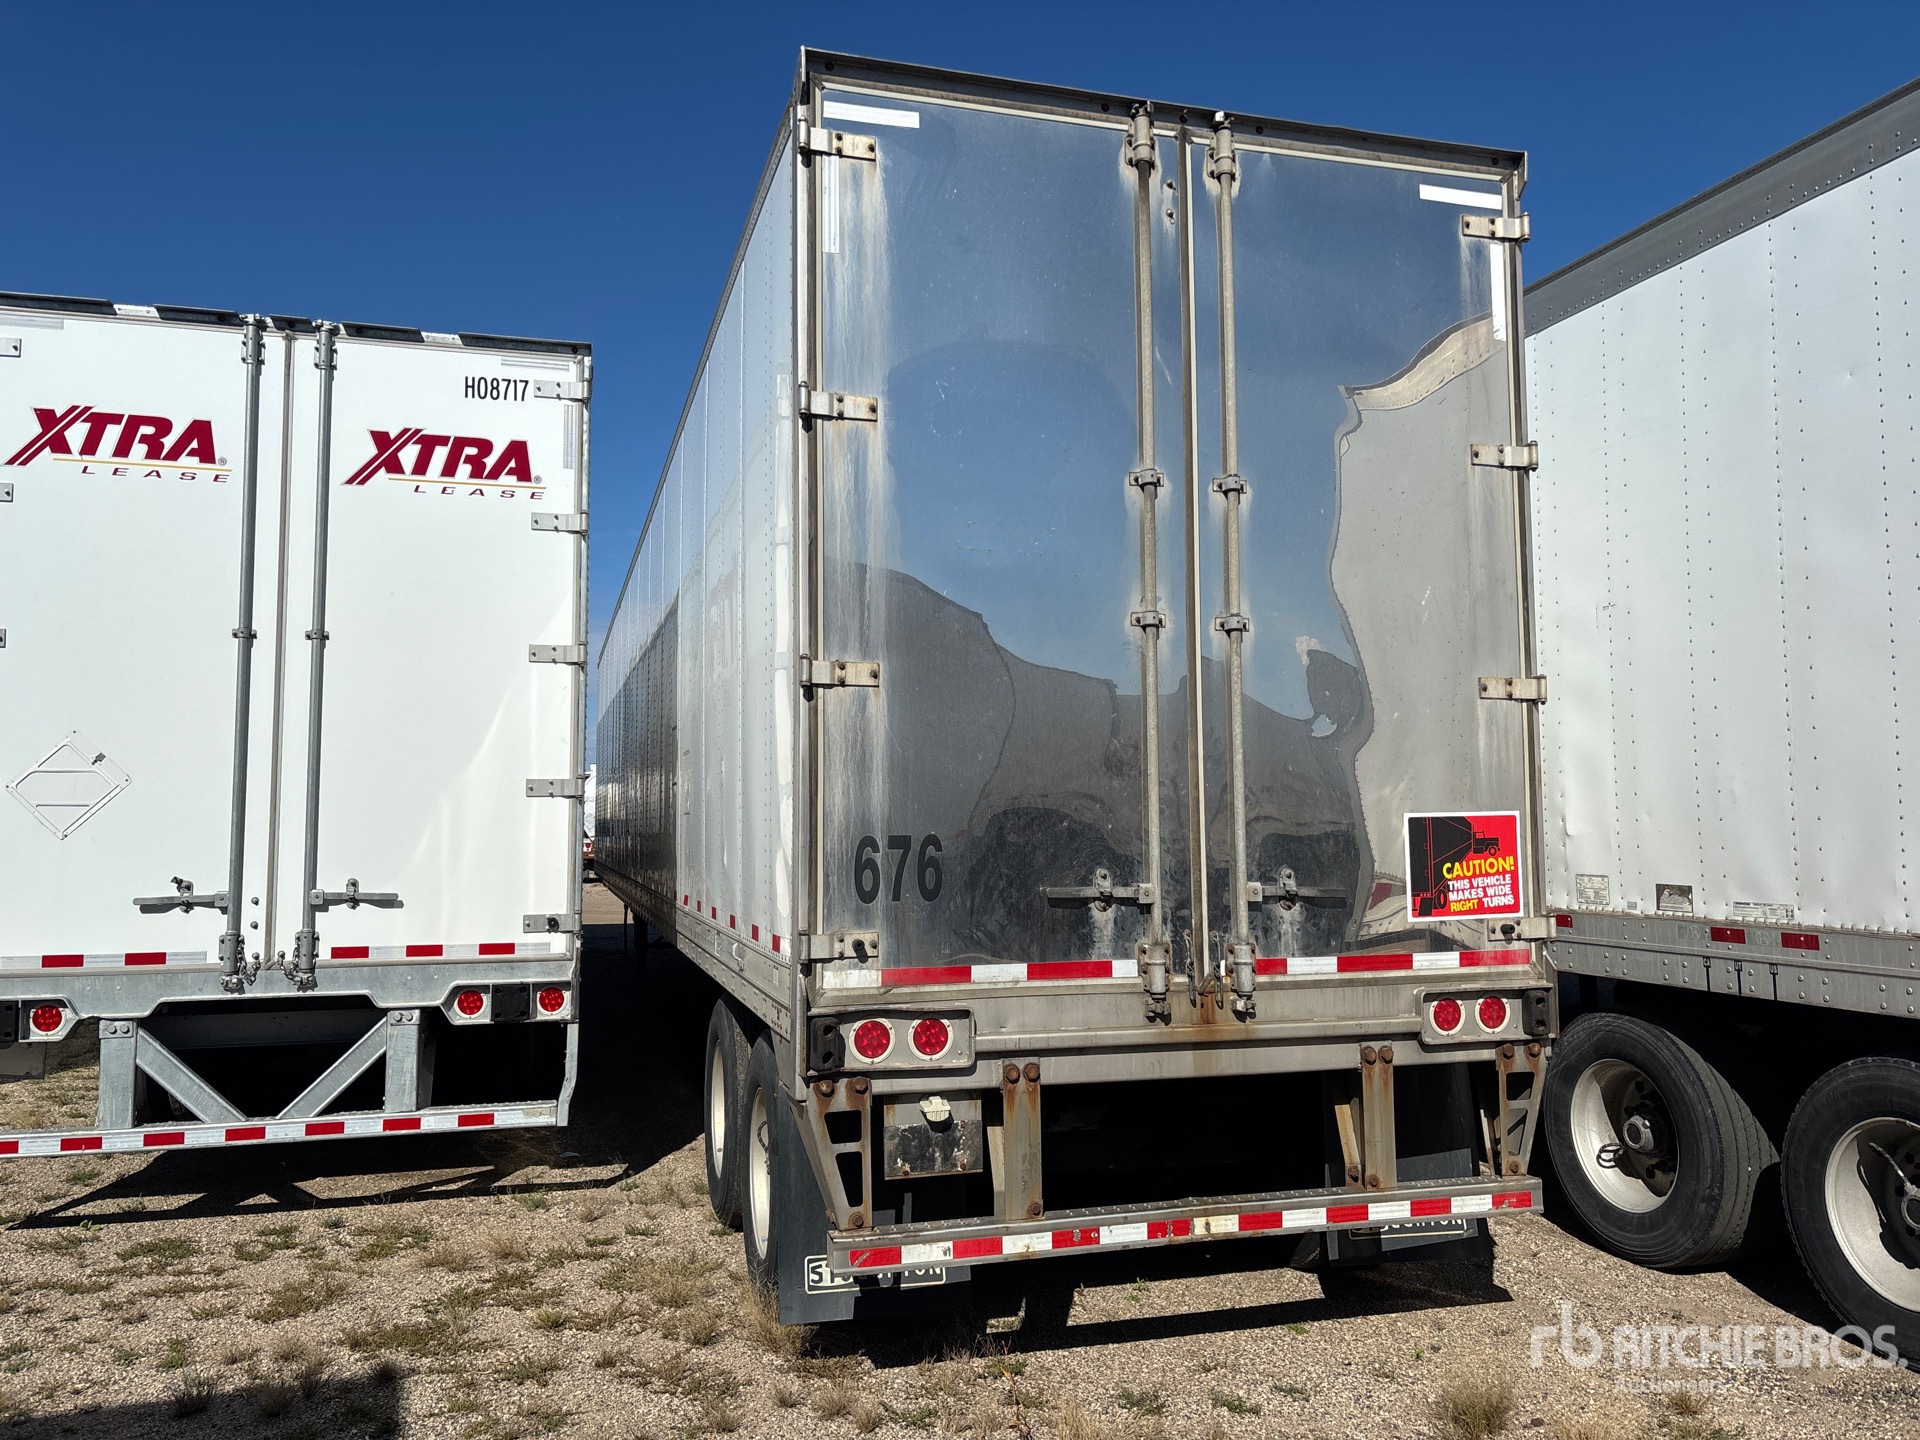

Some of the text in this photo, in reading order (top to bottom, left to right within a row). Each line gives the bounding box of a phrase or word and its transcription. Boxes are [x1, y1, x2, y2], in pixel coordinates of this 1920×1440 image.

[464, 376, 529, 402] H08717
[5, 405, 217, 466] XTRA
[344, 427, 533, 486] XTRA
[82, 466, 230, 484] LEASE
[414, 484, 545, 501] LEASE
[854, 833, 943, 905] 676
[1442, 856, 1515, 879] CAUTION!
[1447, 874, 1512, 891] THIS VEHICLE
[1448, 884, 1512, 902] MAKES WIDE
[1450, 895, 1515, 912] RIGHT TURNS
